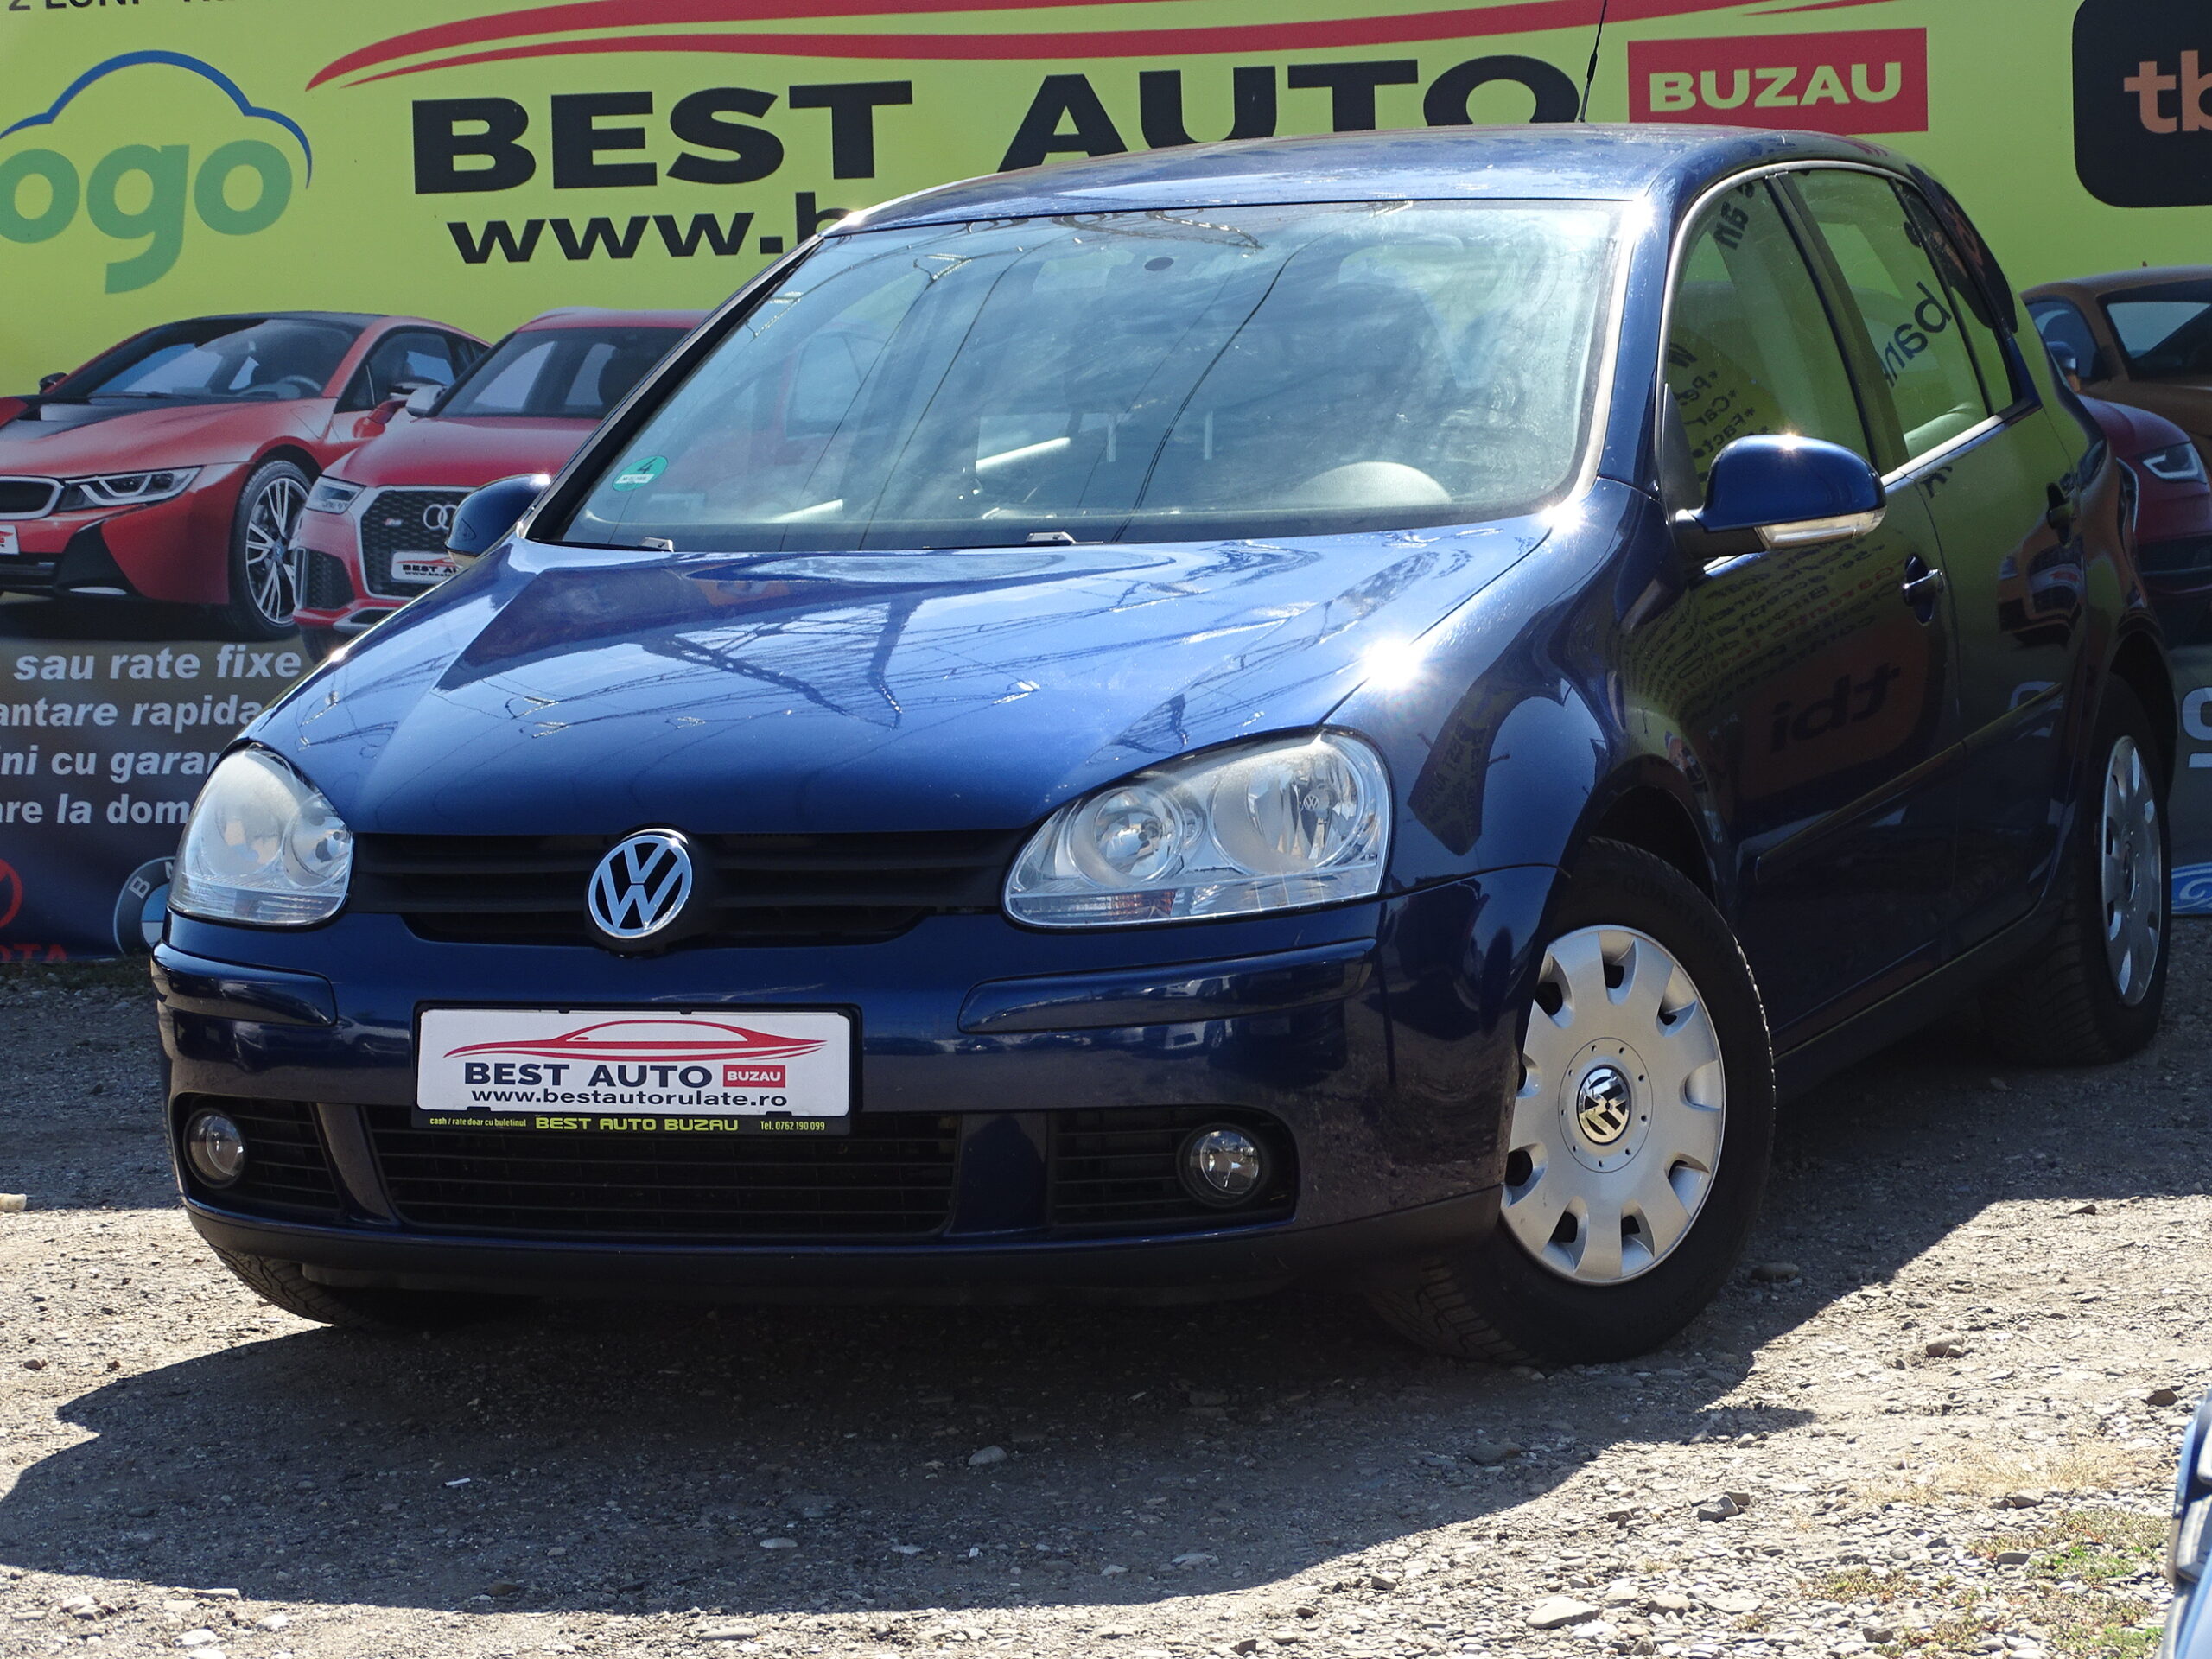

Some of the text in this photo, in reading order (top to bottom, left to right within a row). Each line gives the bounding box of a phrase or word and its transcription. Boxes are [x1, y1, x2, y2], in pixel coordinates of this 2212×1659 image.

[412, 54, 1902, 194] BEST AUTO BUZAU
[13, 644, 302, 681] sau rate fixe
[0, 745, 40, 775] ni
[51, 753, 97, 775] cu
[0, 801, 44, 823] re
[56, 794, 92, 823] la
[464, 1062, 781, 1089] BEST AUTO BUZAU
[471, 1088, 788, 1107] www.bestautorulate.ro
[494, 1118, 527, 1128] buletinul
[535, 1117, 739, 1132] BEST AUTO BUZAU
[760, 1121, 825, 1131] Tel. 0762 190 099
